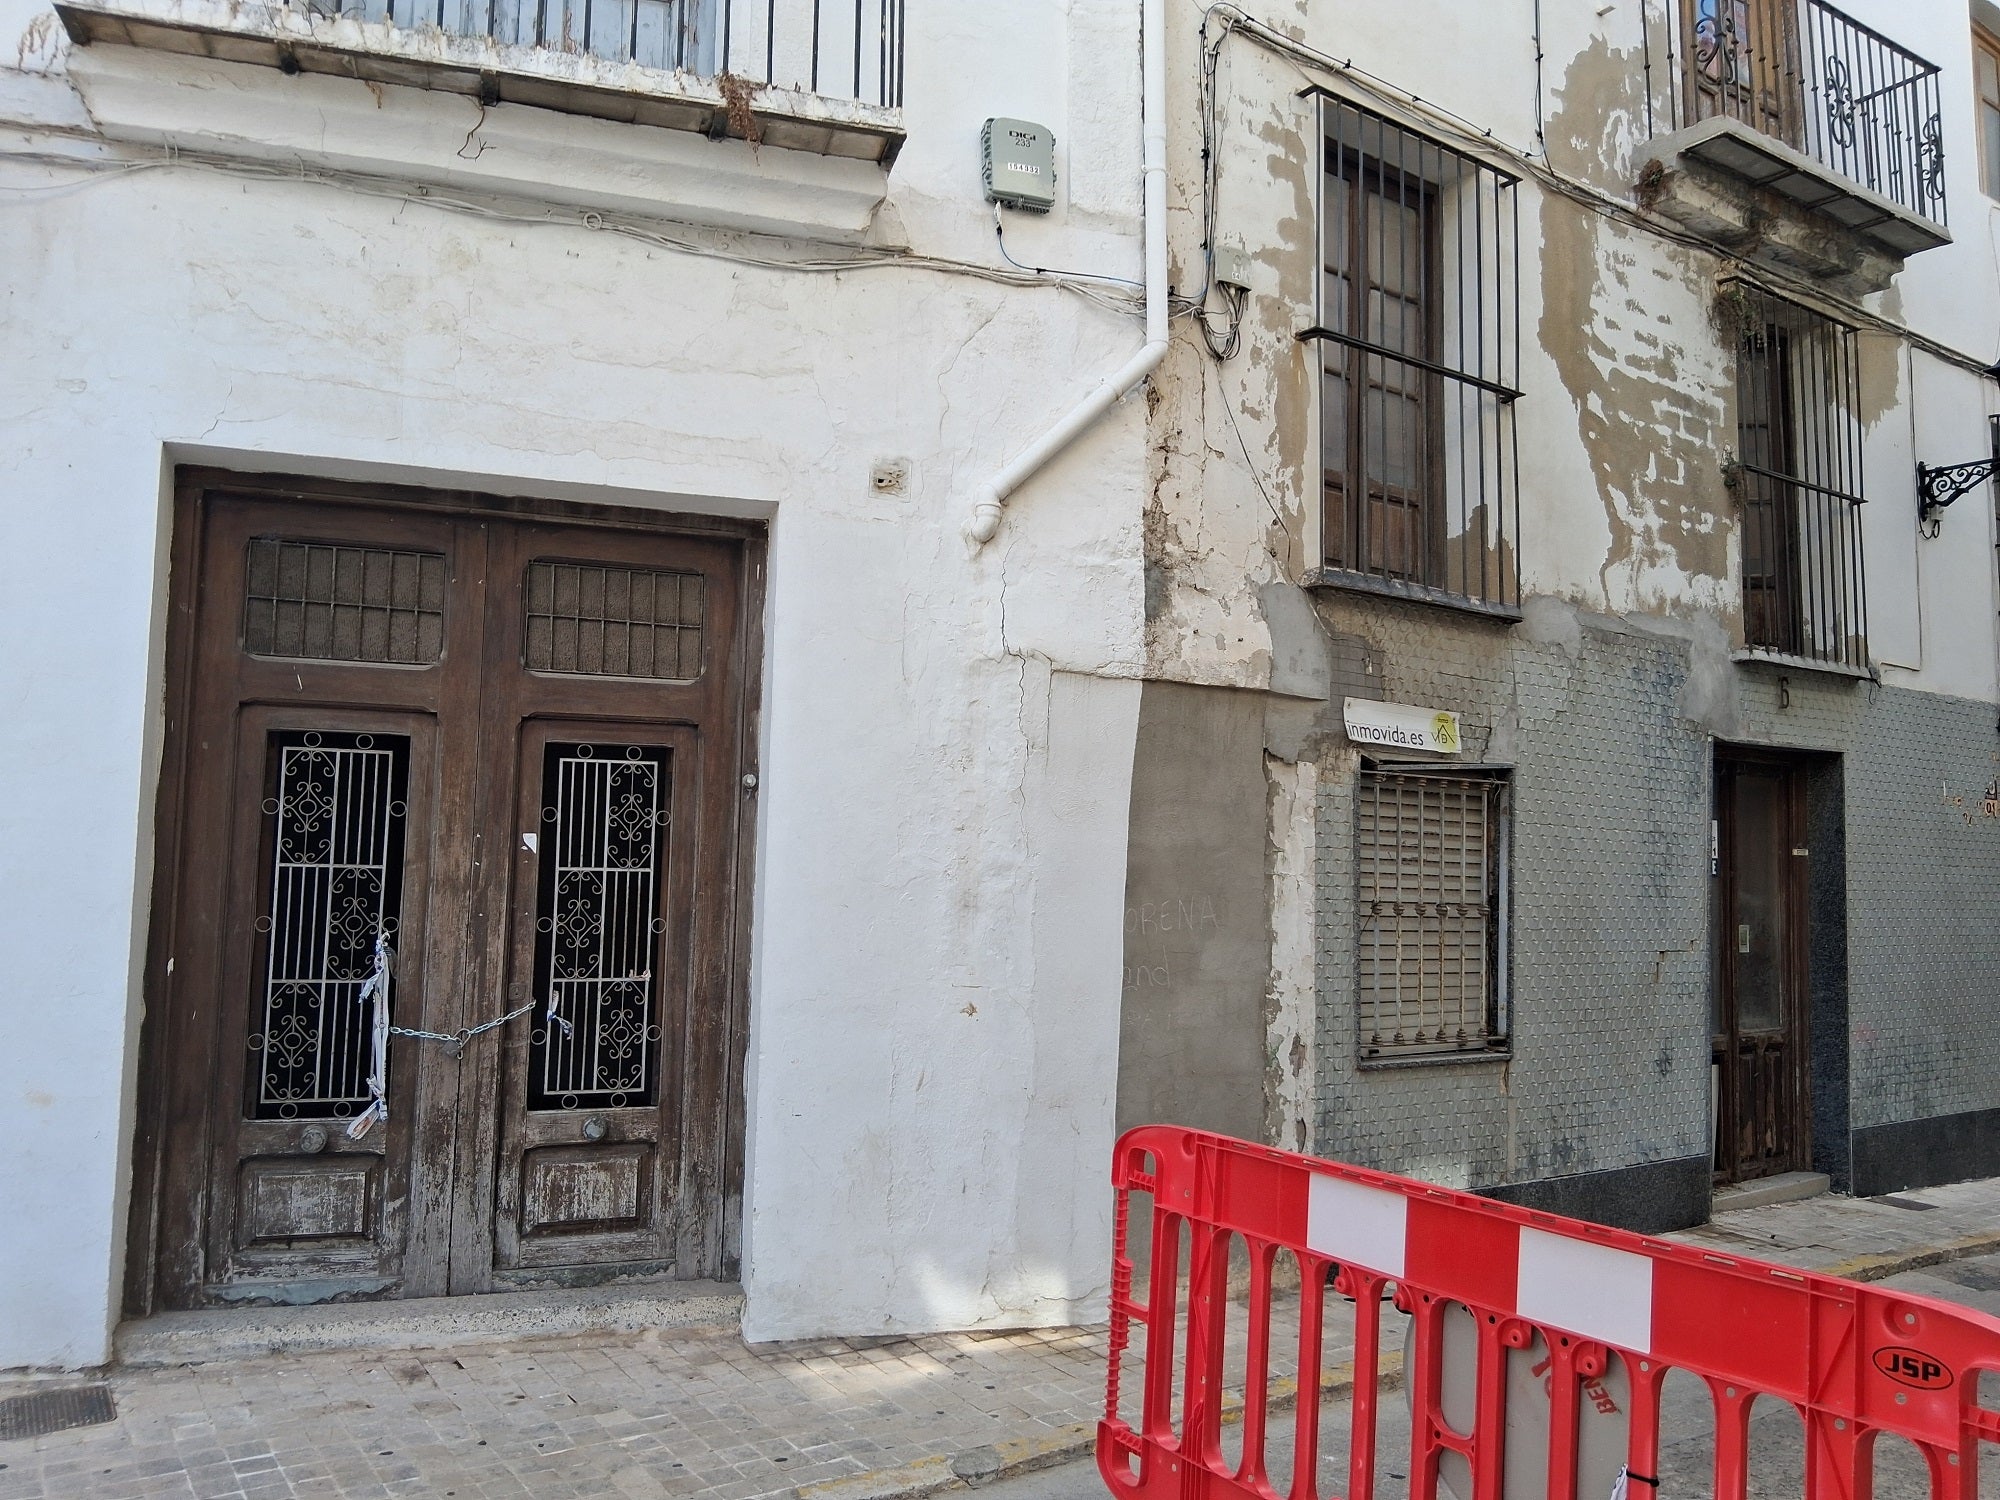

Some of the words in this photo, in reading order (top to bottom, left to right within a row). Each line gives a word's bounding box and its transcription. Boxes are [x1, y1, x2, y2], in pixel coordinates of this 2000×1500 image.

[1008, 130, 1036, 141] DIGI
[1015, 138, 1031, 148] 233
[1346, 720, 1424, 746] inmovida.es
[1885, 1353, 1941, 1382] JSP
